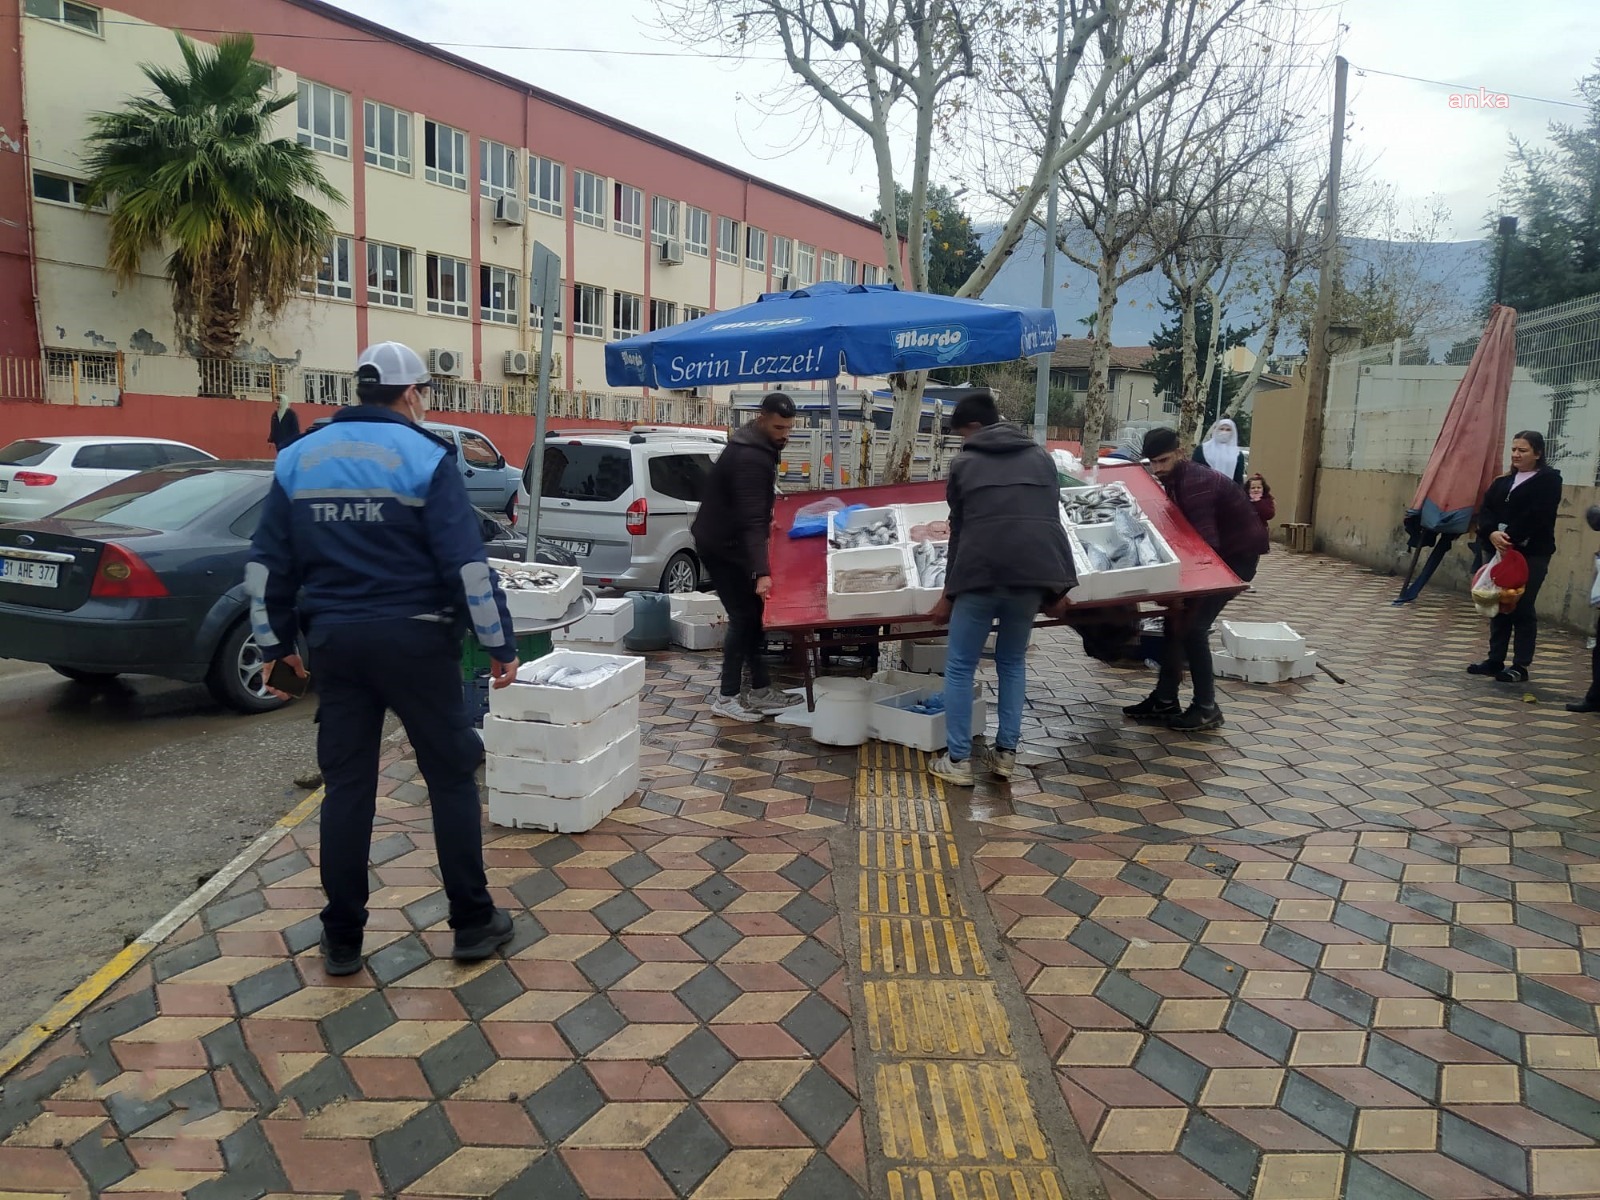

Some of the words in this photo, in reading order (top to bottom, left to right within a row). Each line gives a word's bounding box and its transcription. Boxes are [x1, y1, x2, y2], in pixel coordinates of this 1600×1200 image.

[895, 329, 962, 349] Mardo
[670, 353, 731, 382] Serin
[738, 345, 824, 376] Lezzet!
[310, 498, 385, 522] TRAFİK
[4, 561, 13, 576] 31
[18, 562, 34, 579] AHE
[38, 565, 56, 581] 377
